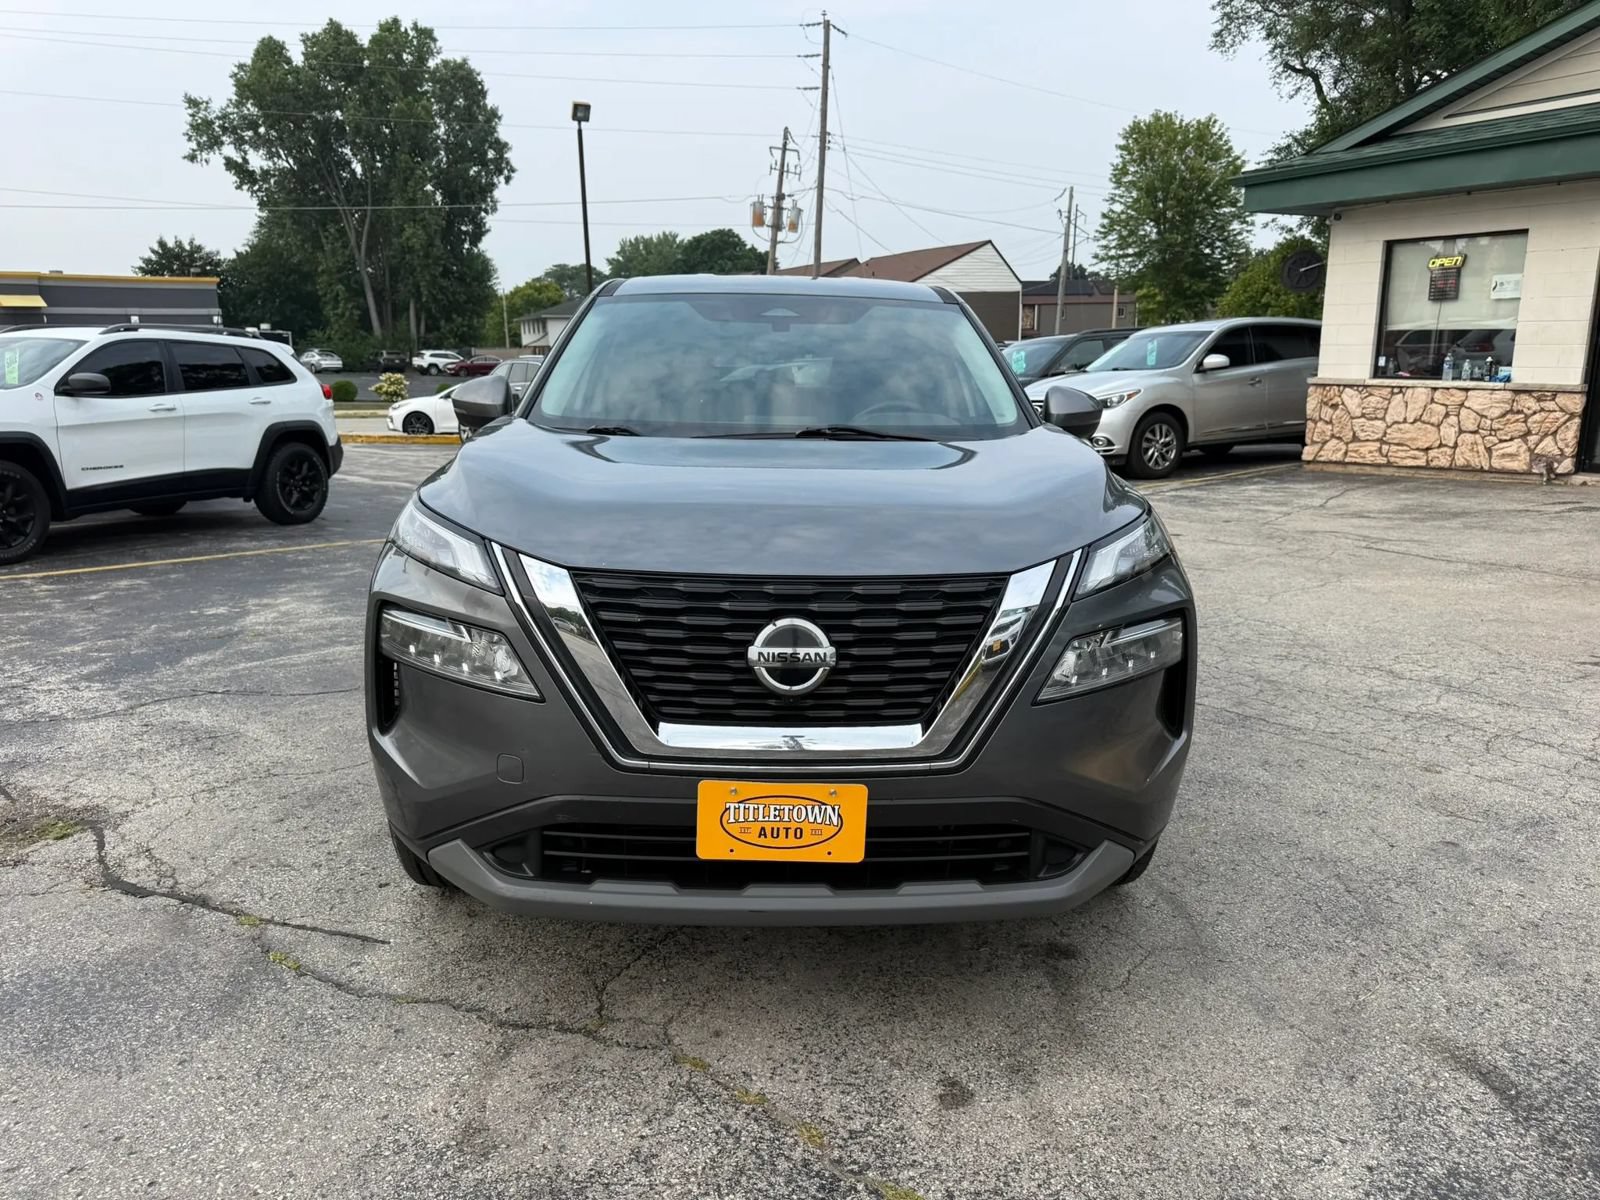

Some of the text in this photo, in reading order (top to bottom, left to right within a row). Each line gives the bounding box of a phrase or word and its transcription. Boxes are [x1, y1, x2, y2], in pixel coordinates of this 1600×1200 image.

[1428, 256, 1462, 268] OPEN
[757, 651, 827, 663] NISSAN
[725, 802, 840, 827] TITLETOWN
[758, 827, 804, 839] AUTO
